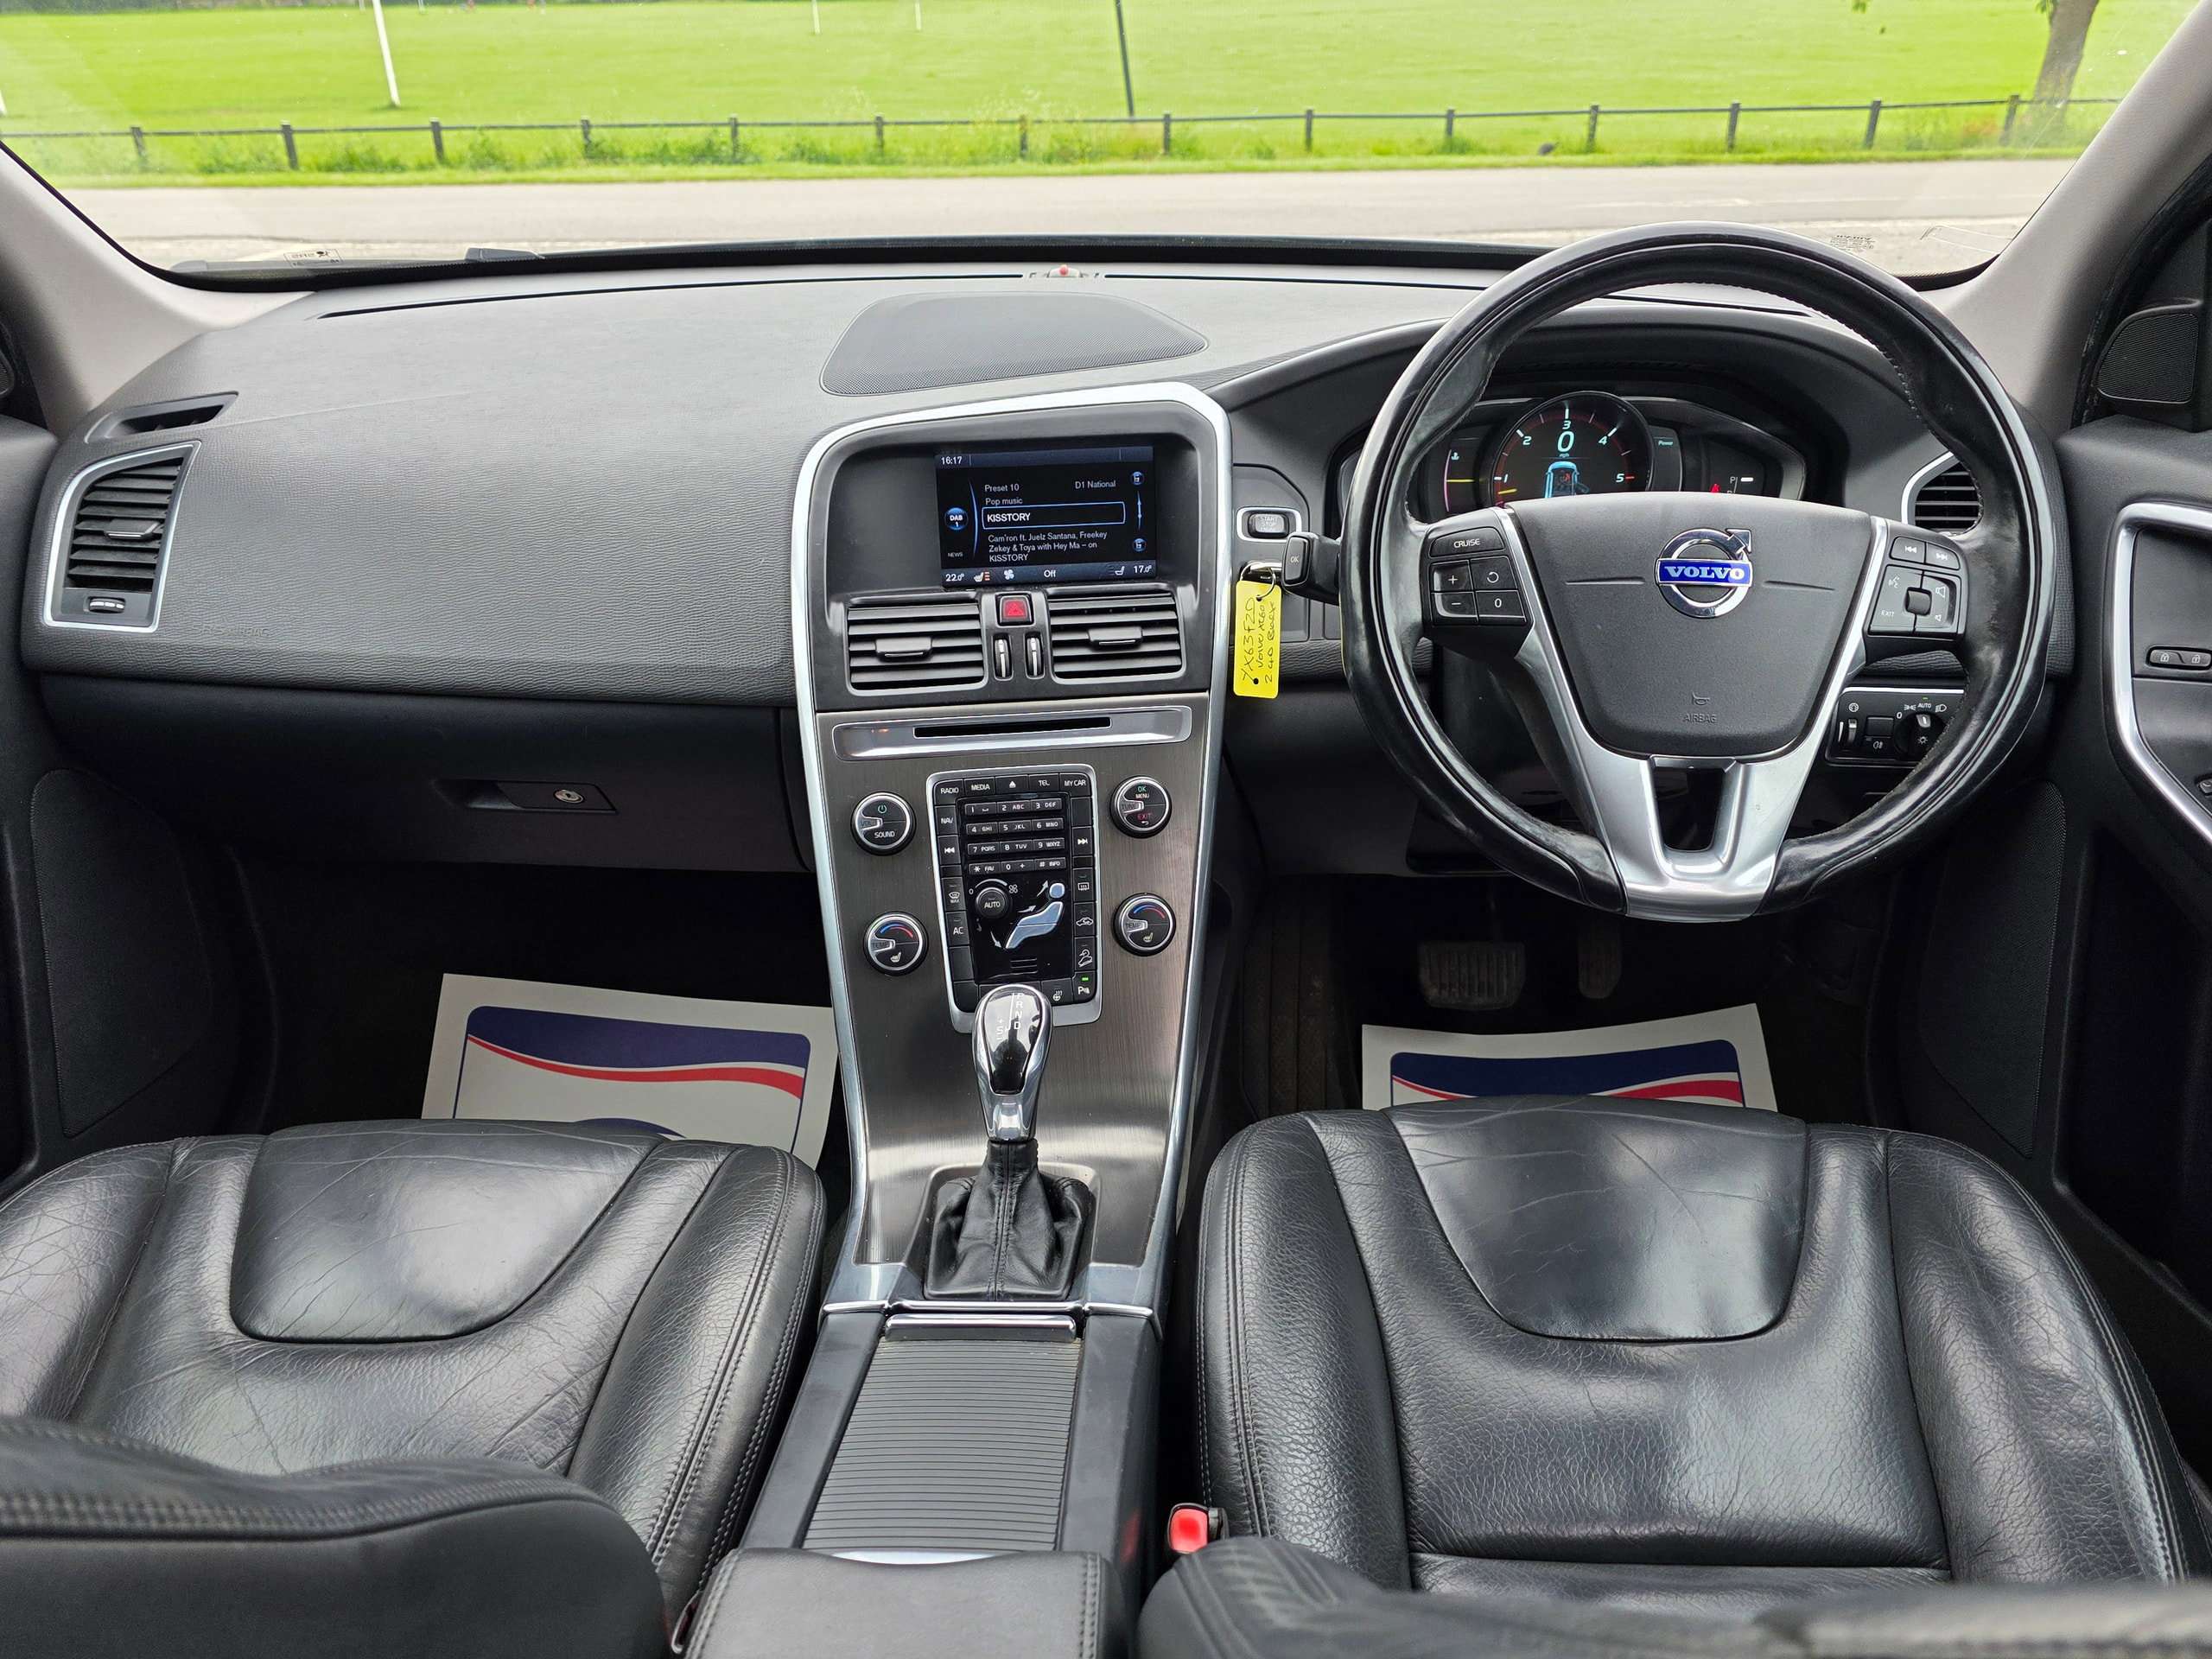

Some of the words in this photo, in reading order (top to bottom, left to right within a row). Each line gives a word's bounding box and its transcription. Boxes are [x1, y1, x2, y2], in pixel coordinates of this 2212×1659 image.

[1522, 436, 1531, 445] 2
[1557, 431, 1574, 452] 0
[1598, 435, 1608, 445] 4
[984, 484, 1008, 493] Preset
[985, 498, 1001, 506] Pop
[987, 512, 1031, 522] KISSTORY
[1454, 539, 1480, 548] CRUISE
[989, 544, 1010, 553] Zekey
[1664, 566, 1745, 580] VOLVO
[1683, 713, 1717, 722] AIRBAG
[1014, 1021, 1020, 1030] D
[997, 1027, 1003, 1035] S
